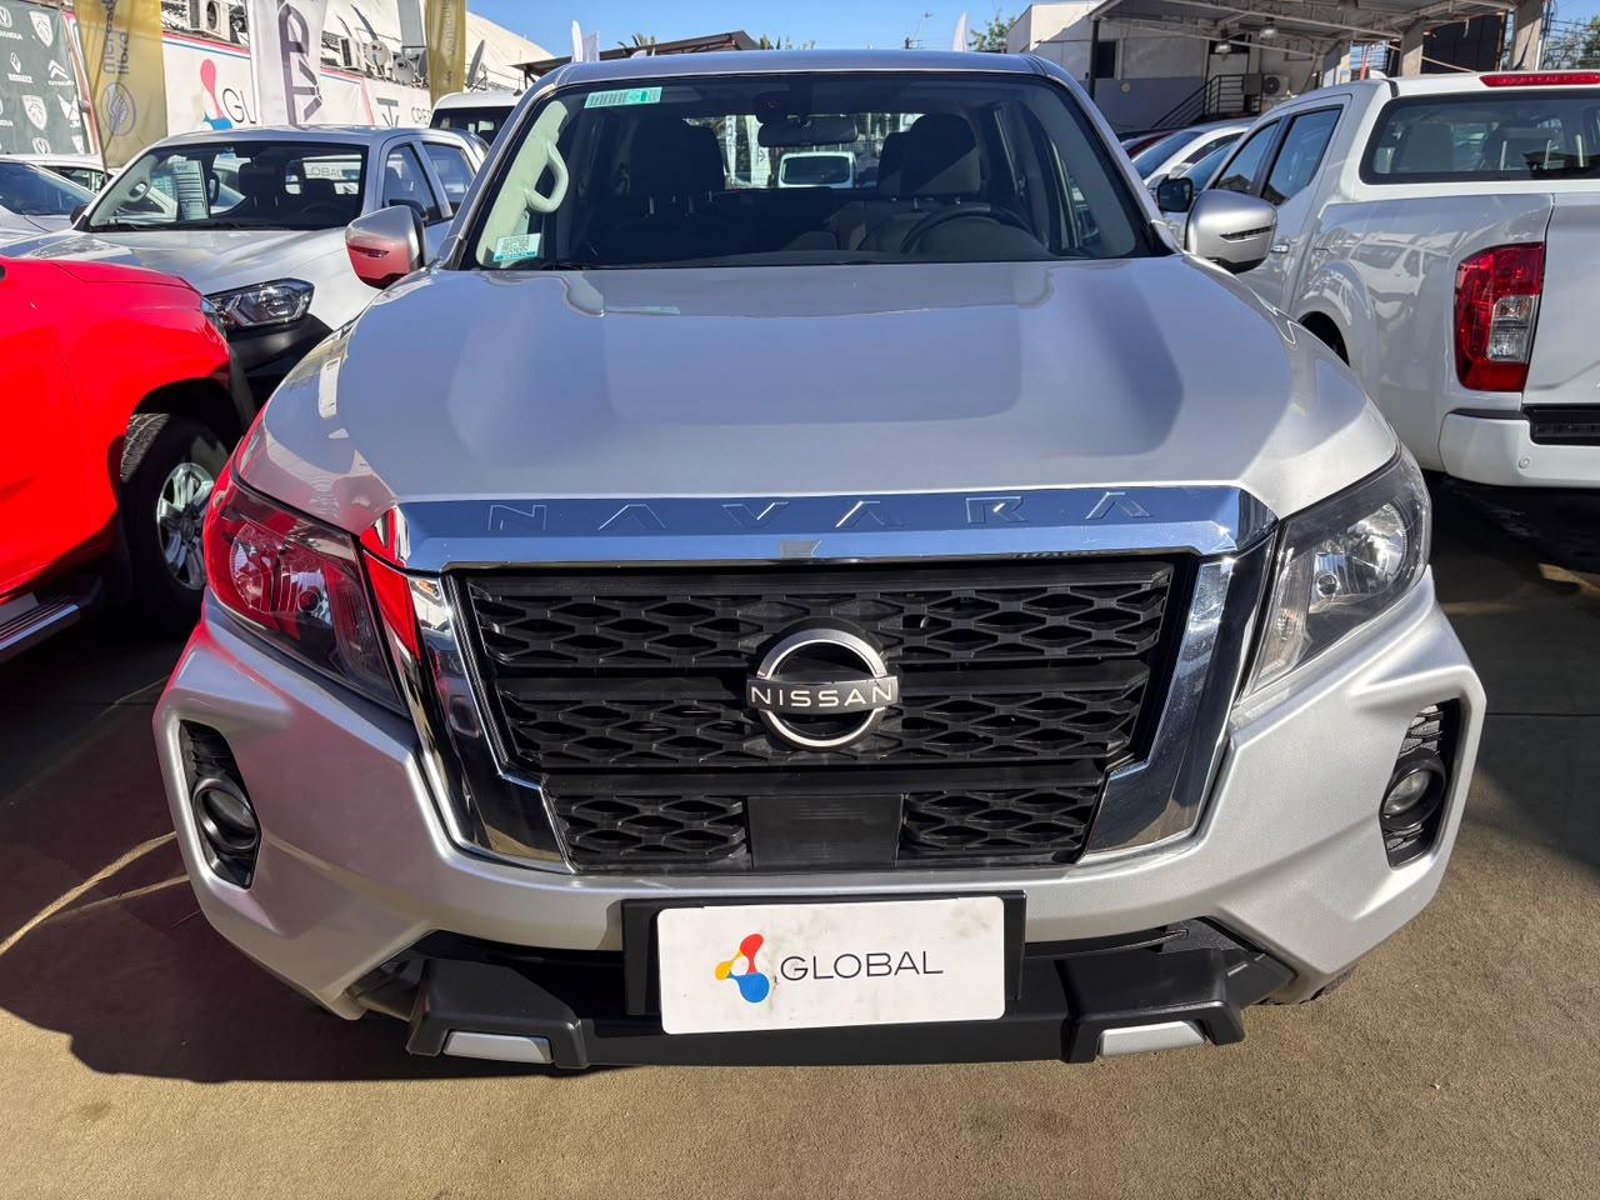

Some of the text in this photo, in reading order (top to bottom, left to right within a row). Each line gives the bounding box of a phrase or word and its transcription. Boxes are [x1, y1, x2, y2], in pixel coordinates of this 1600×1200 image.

[222, 87, 257, 125] GL
[488, 490, 1153, 532] NAVARA
[750, 684, 893, 708] NISSAN
[780, 950, 944, 982] GLOBAL
